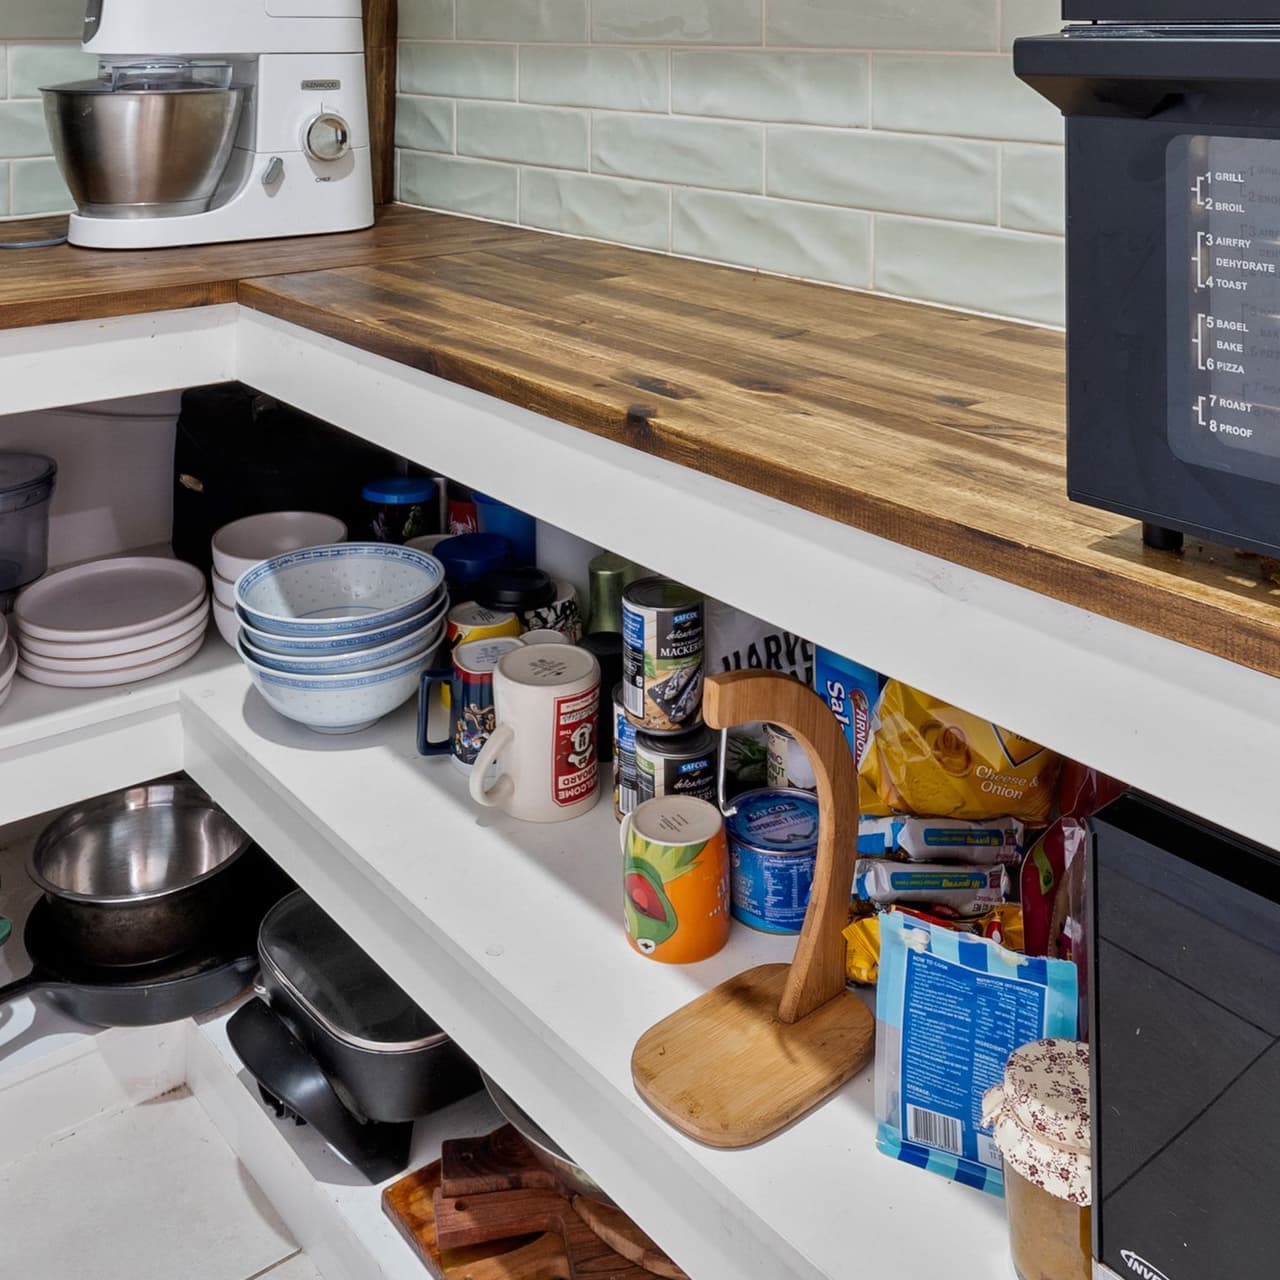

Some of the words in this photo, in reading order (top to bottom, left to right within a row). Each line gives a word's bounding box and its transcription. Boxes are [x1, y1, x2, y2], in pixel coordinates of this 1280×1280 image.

[305, 81, 337, 89] KENWOOD
[1205, 172, 1211, 184] 1
[1215, 172, 1244, 183] GRILL
[1205, 198, 1213, 210] 2
[1215, 202, 1245, 213] BROIL
[1206, 234, 1213, 246] 3
[1216, 238, 1251, 249] AIRFRY
[1216, 258, 1275, 273] DEHYDRATE
[1206, 276, 1214, 288] 4
[1216, 279, 1248, 291] TOAST
[1206, 317, 1214, 328] 5
[1217, 320, 1249, 332] BAGEL
[1217, 341, 1243, 353] BAKE
[1206, 358, 1214, 370] 6
[1217, 362, 1245, 374] PIZZA
[1209, 395, 1217, 407] 7
[1220, 399, 1252, 412] ROAST
[1209, 420, 1217, 432] 8
[1220, 424, 1253, 438] PROOF
[826, 680, 850, 732] Sal
[976, 765, 1027, 786] Cheese
[1029, 776, 1039, 788] &
[981, 780, 1024, 799] Onion
